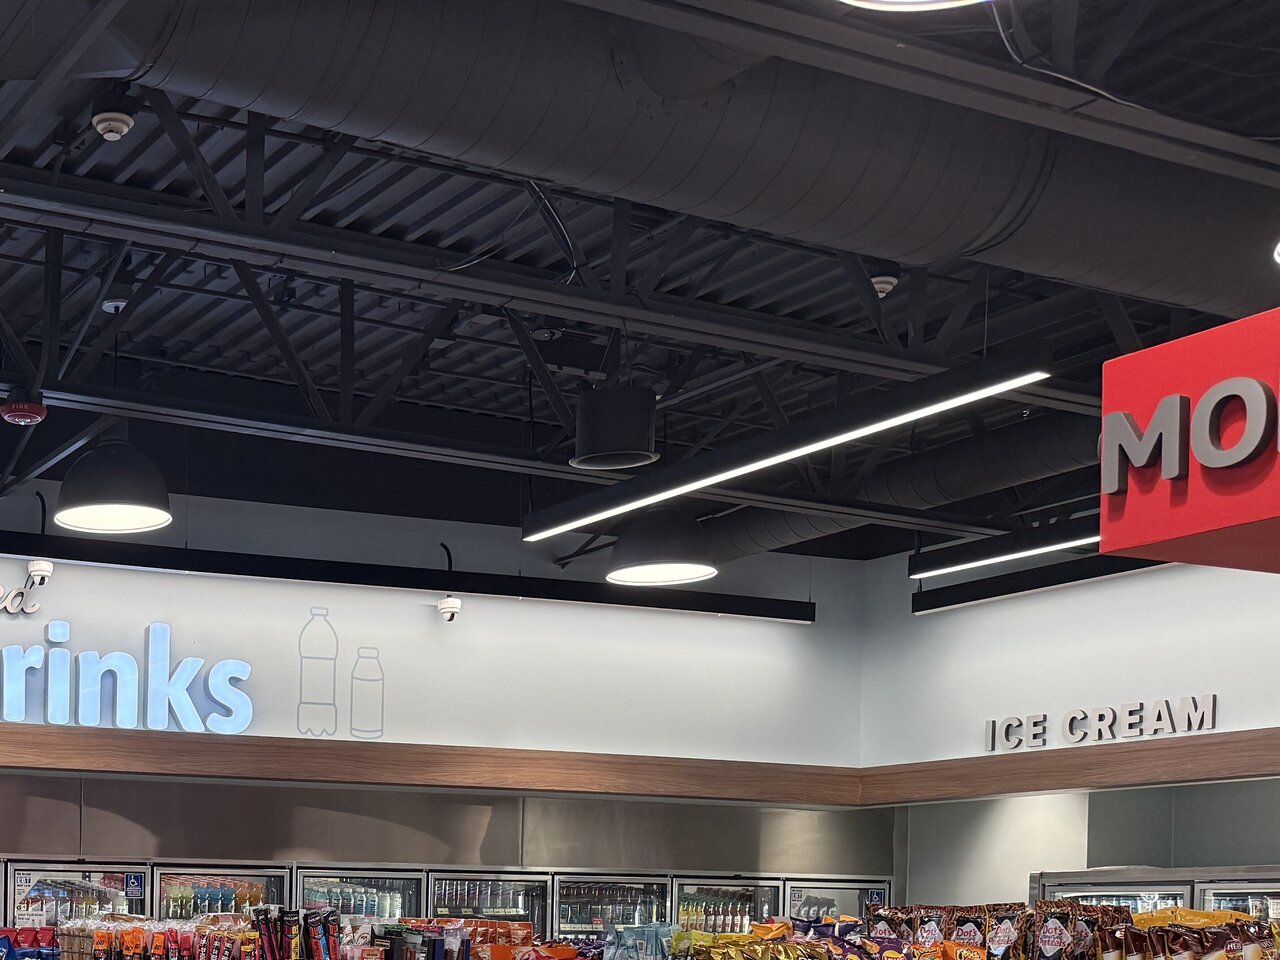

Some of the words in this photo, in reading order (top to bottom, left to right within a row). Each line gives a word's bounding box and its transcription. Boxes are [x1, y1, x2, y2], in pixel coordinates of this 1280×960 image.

[1102, 376, 1280, 495] MO
[985, 714, 1047, 751] ICE
[1063, 694, 1217, 742] CREAM
[1040, 938, 1067, 947] Pretzels
[1043, 925, 1064, 934] Dot's
